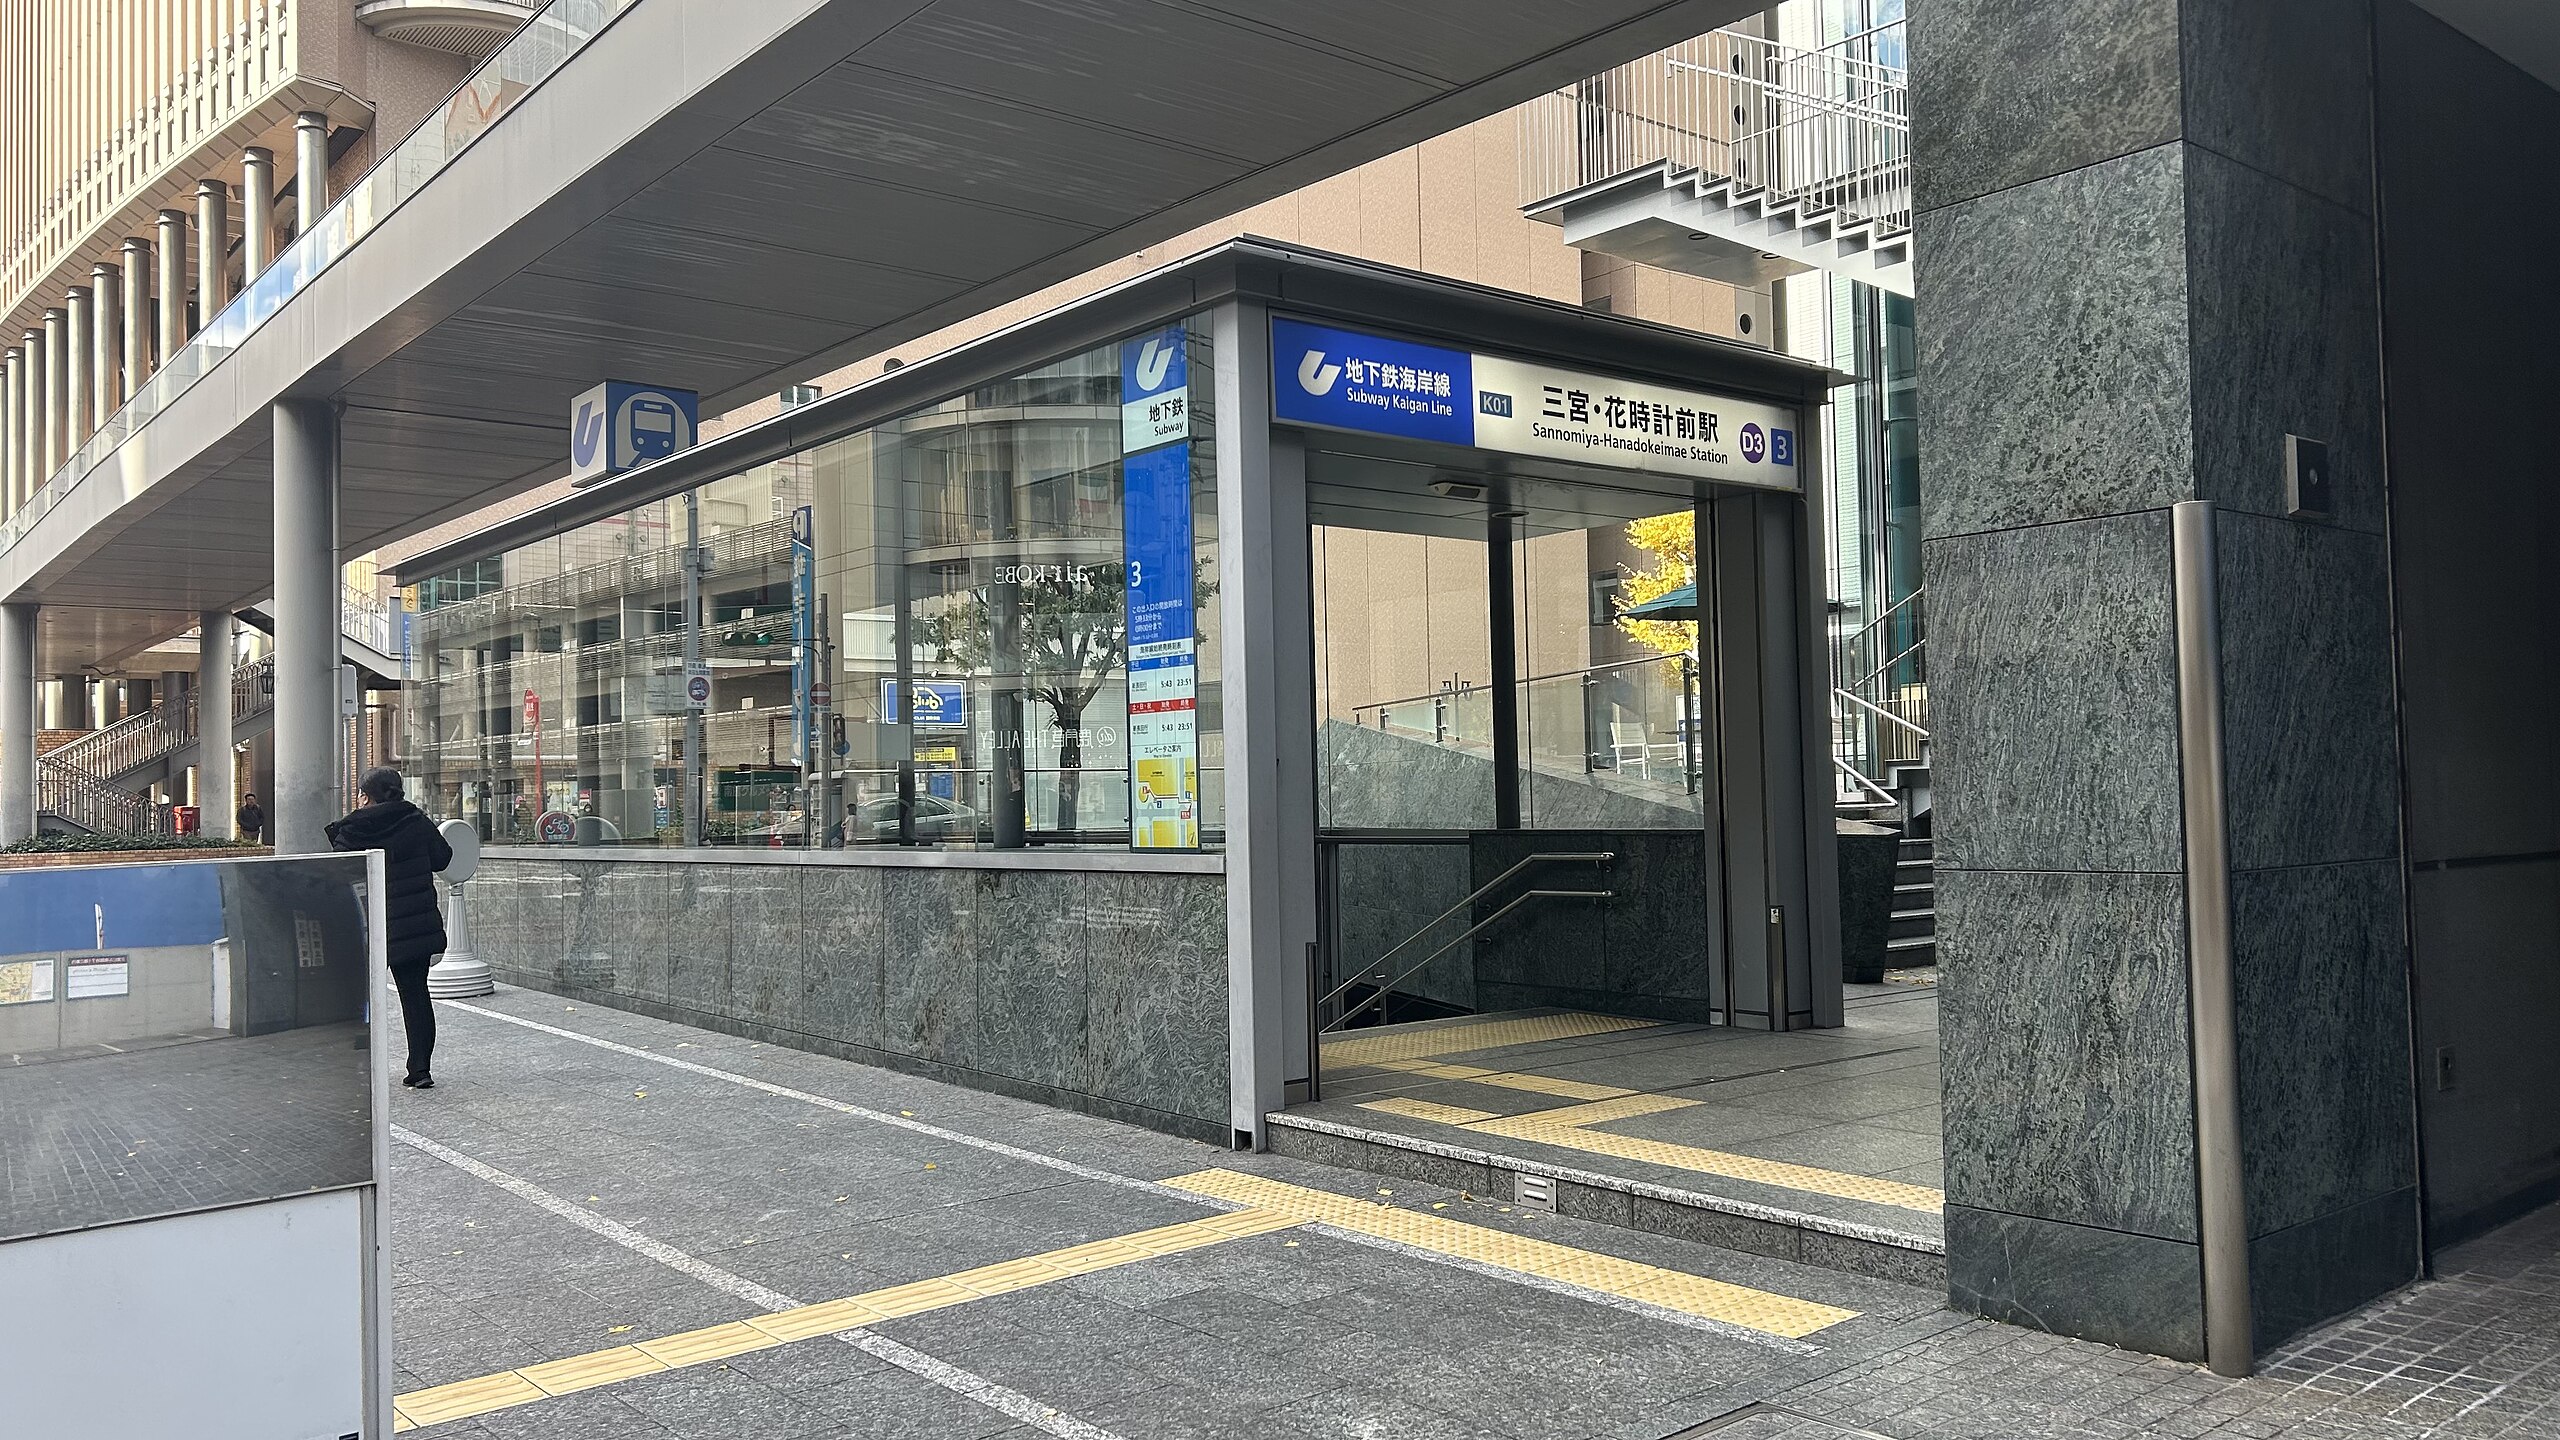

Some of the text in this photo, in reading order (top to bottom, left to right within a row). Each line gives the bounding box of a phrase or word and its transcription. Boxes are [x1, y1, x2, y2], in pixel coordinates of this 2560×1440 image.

[1345, 356, 1452, 397] 地下鉄海岸線
[1149, 396, 1184, 423] 地下鉄
[1346, 387, 1453, 417] Subway Kaigan Line
[1483, 395, 1510, 416] K01
[1541, 385, 1719, 445] 三宮・花時計前駅
[1154, 420, 1184, 437] Subway
[1532, 421, 1729, 465] Sannomiya-Hanadokeimae Station
[1741, 431, 1764, 456] D3
[1777, 436, 1788, 460] 3
[1131, 561, 1142, 587] 3
[1161, 680, 1172, 688] 5:43
[1177, 678, 1192, 687] 23:51
[1162, 724, 1174, 732] 5:43
[1178, 722, 1193, 731] 23:51
